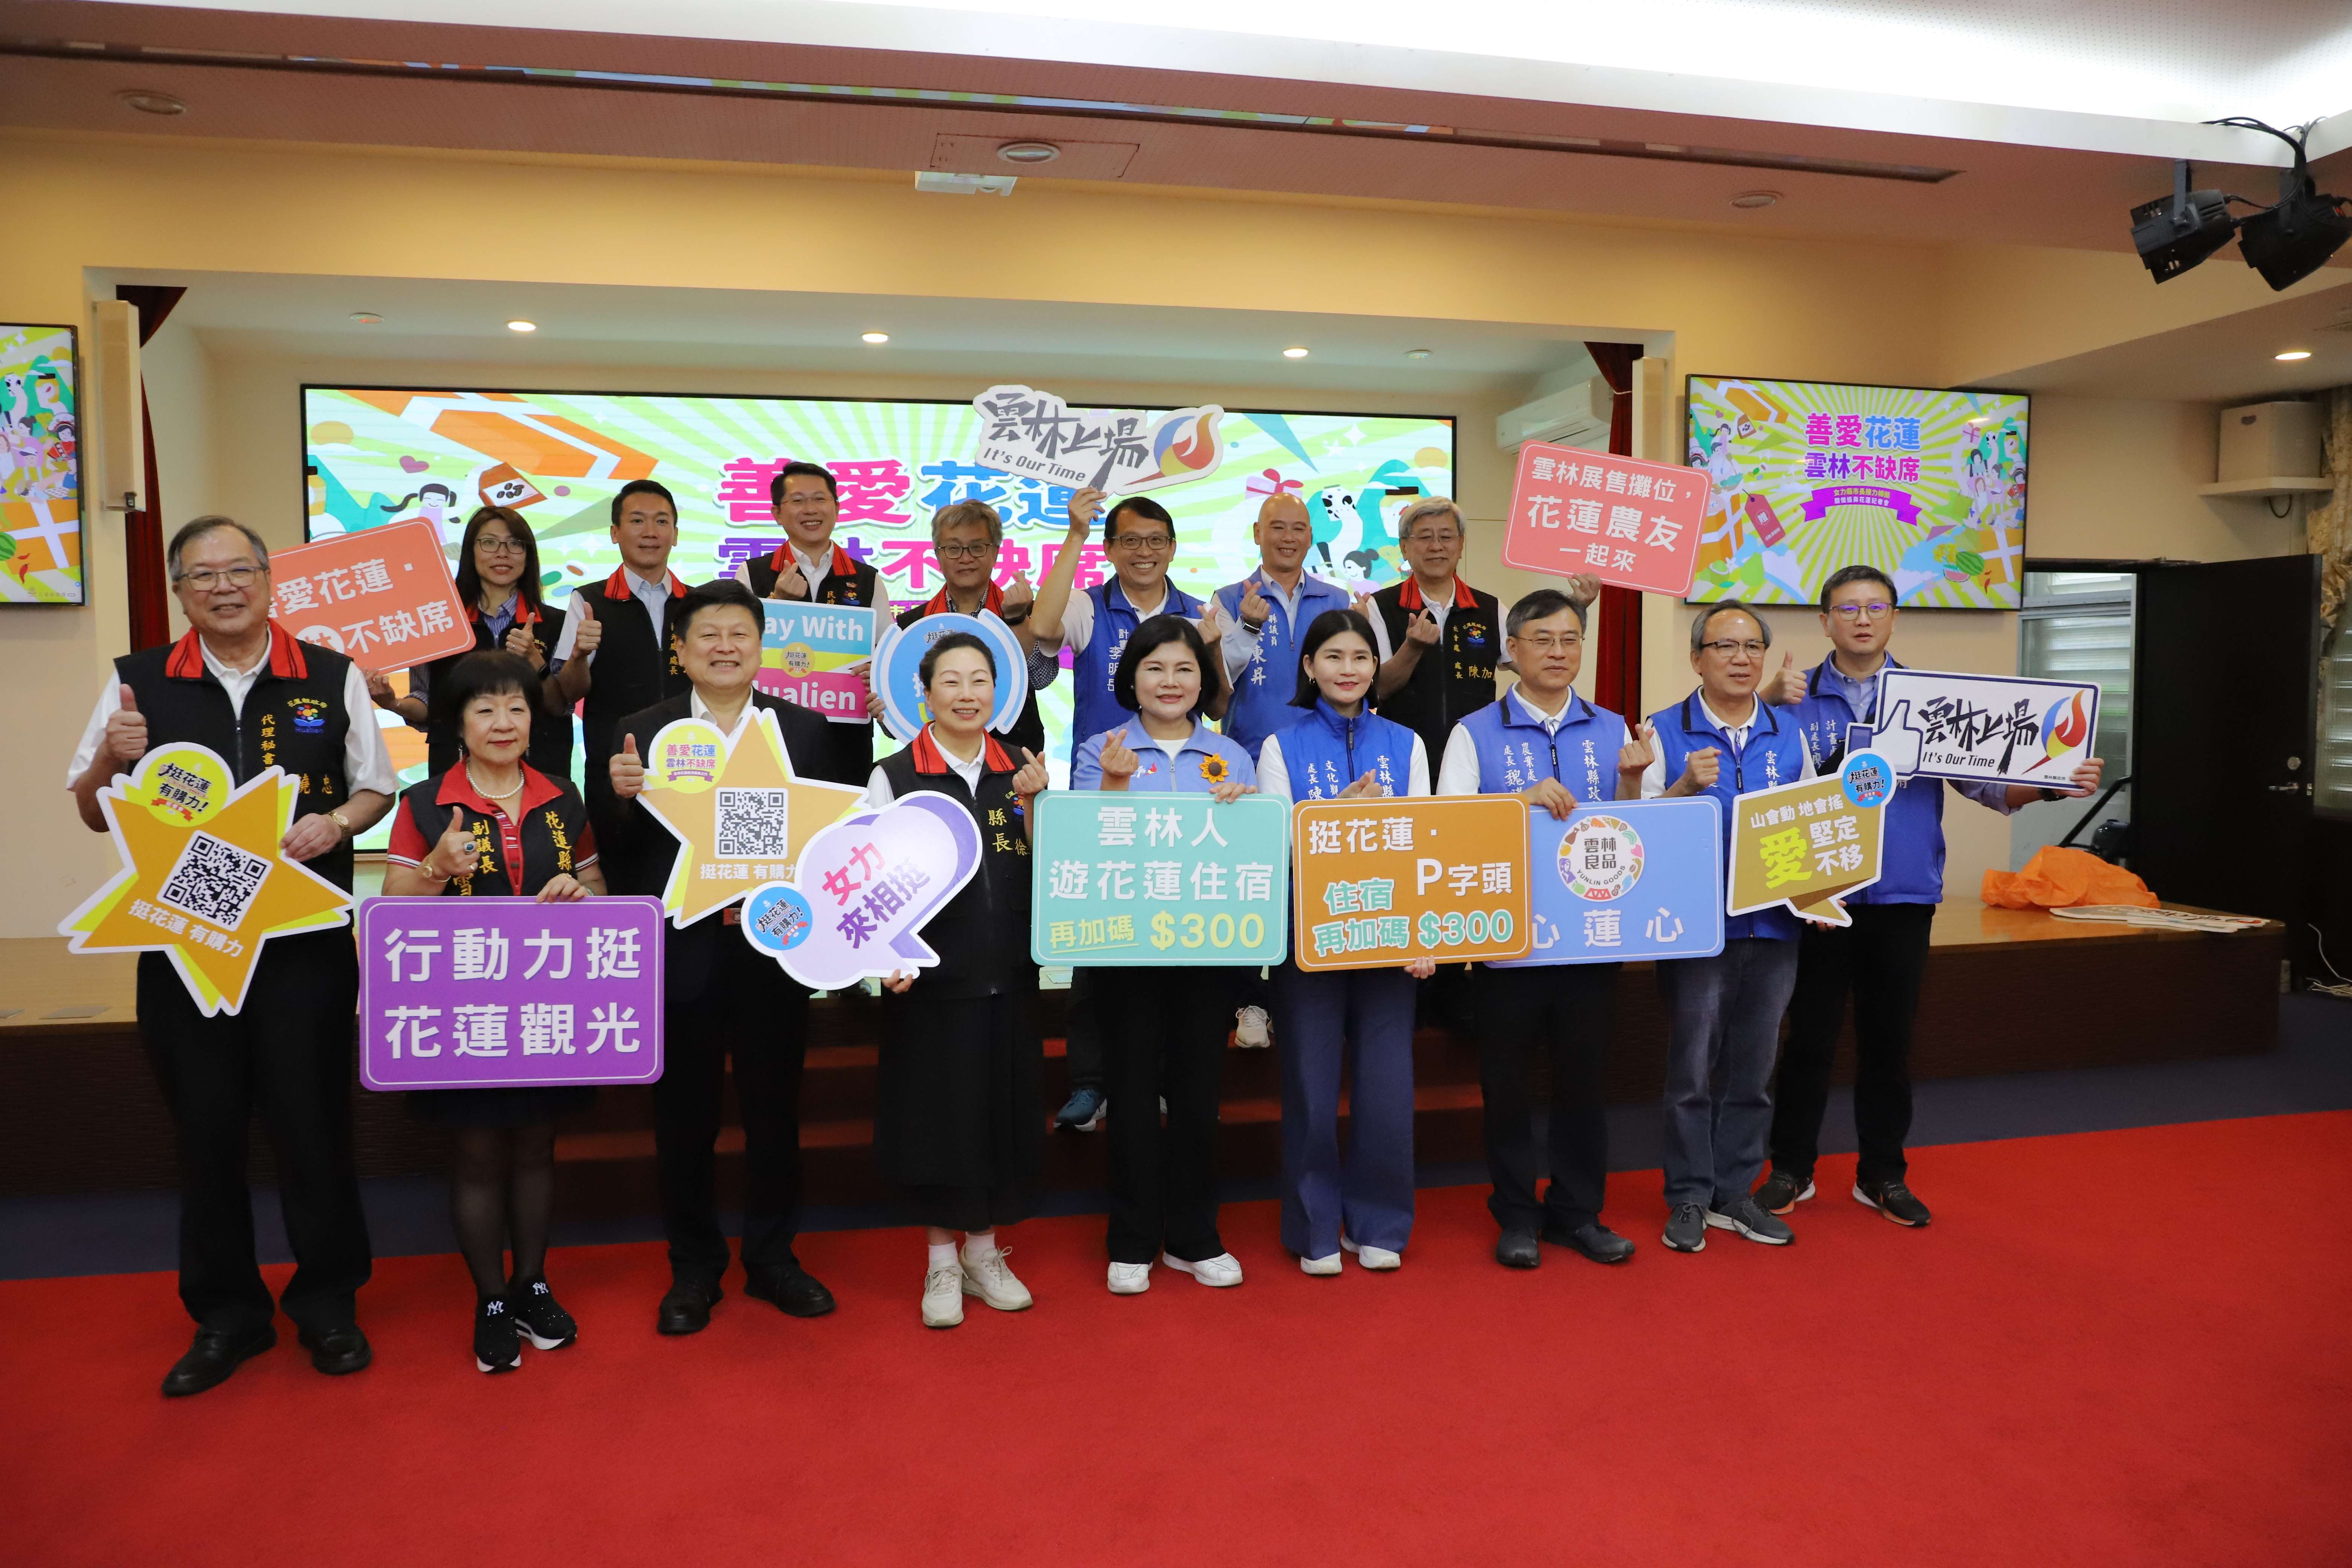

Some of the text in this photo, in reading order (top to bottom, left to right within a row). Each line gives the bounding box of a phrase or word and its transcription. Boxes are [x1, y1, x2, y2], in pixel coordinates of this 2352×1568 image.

[1805, 413, 1920, 449] 善愛花蓮
[983, 447, 1086, 482] It's Our Time
[1532, 456, 1691, 502] 雲林展售攤位，
[1805, 453, 1920, 482] 雲林不缺席
[1527, 495, 1683, 552] 花蓮農友
[1560, 543, 1636, 572] 一起來
[765, 616, 863, 641] ay With
[1468, 665, 1496, 681] 陳加
[751, 680, 856, 710] ualien
[261, 714, 276, 770] 代理秘書
[666, 744, 716, 756] 善愛花蓮
[666, 758, 716, 769] 雲林不缺席
[1521, 742, 1539, 781] 農業處
[1850, 767, 1878, 784] 挺花蓮
[1923, 752, 1995, 767] It's Our Time
[158, 763, 211, 793] 挺花蓮
[160, 783, 209, 812] 有購力!
[1750, 794, 1844, 828] 山會動 地會搖
[1098, 807, 1228, 848] 雲林人
[1809, 815, 1859, 848] 堅定
[472, 819, 499, 874] 副議長
[1584, 837, 1616, 853] 雲林
[1585, 854, 1616, 870] 良品
[1760, 827, 1812, 889] 愛
[1815, 844, 1864, 876] 不移
[700, 863, 749, 880] 挺花蓮
[822, 842, 885, 906] 女力
[1049, 860, 1274, 901] 遊花蓮住宿
[1417, 858, 1512, 896] P字頭
[1577, 865, 1625, 885] YUNLIN GOODS
[836, 856, 932, 949] 來相挺
[1323, 877, 1394, 915] 住宿
[128, 899, 244, 957] 挺花蓮 有購力
[757, 899, 789, 933] 挺花蓮
[1049, 911, 1265, 950] 再加碼 $300
[1312, 909, 1513, 957] 再加碼 $300
[384, 927, 641, 982] 行動力挺
[384, 1002, 640, 1059] 花蓮觀光
